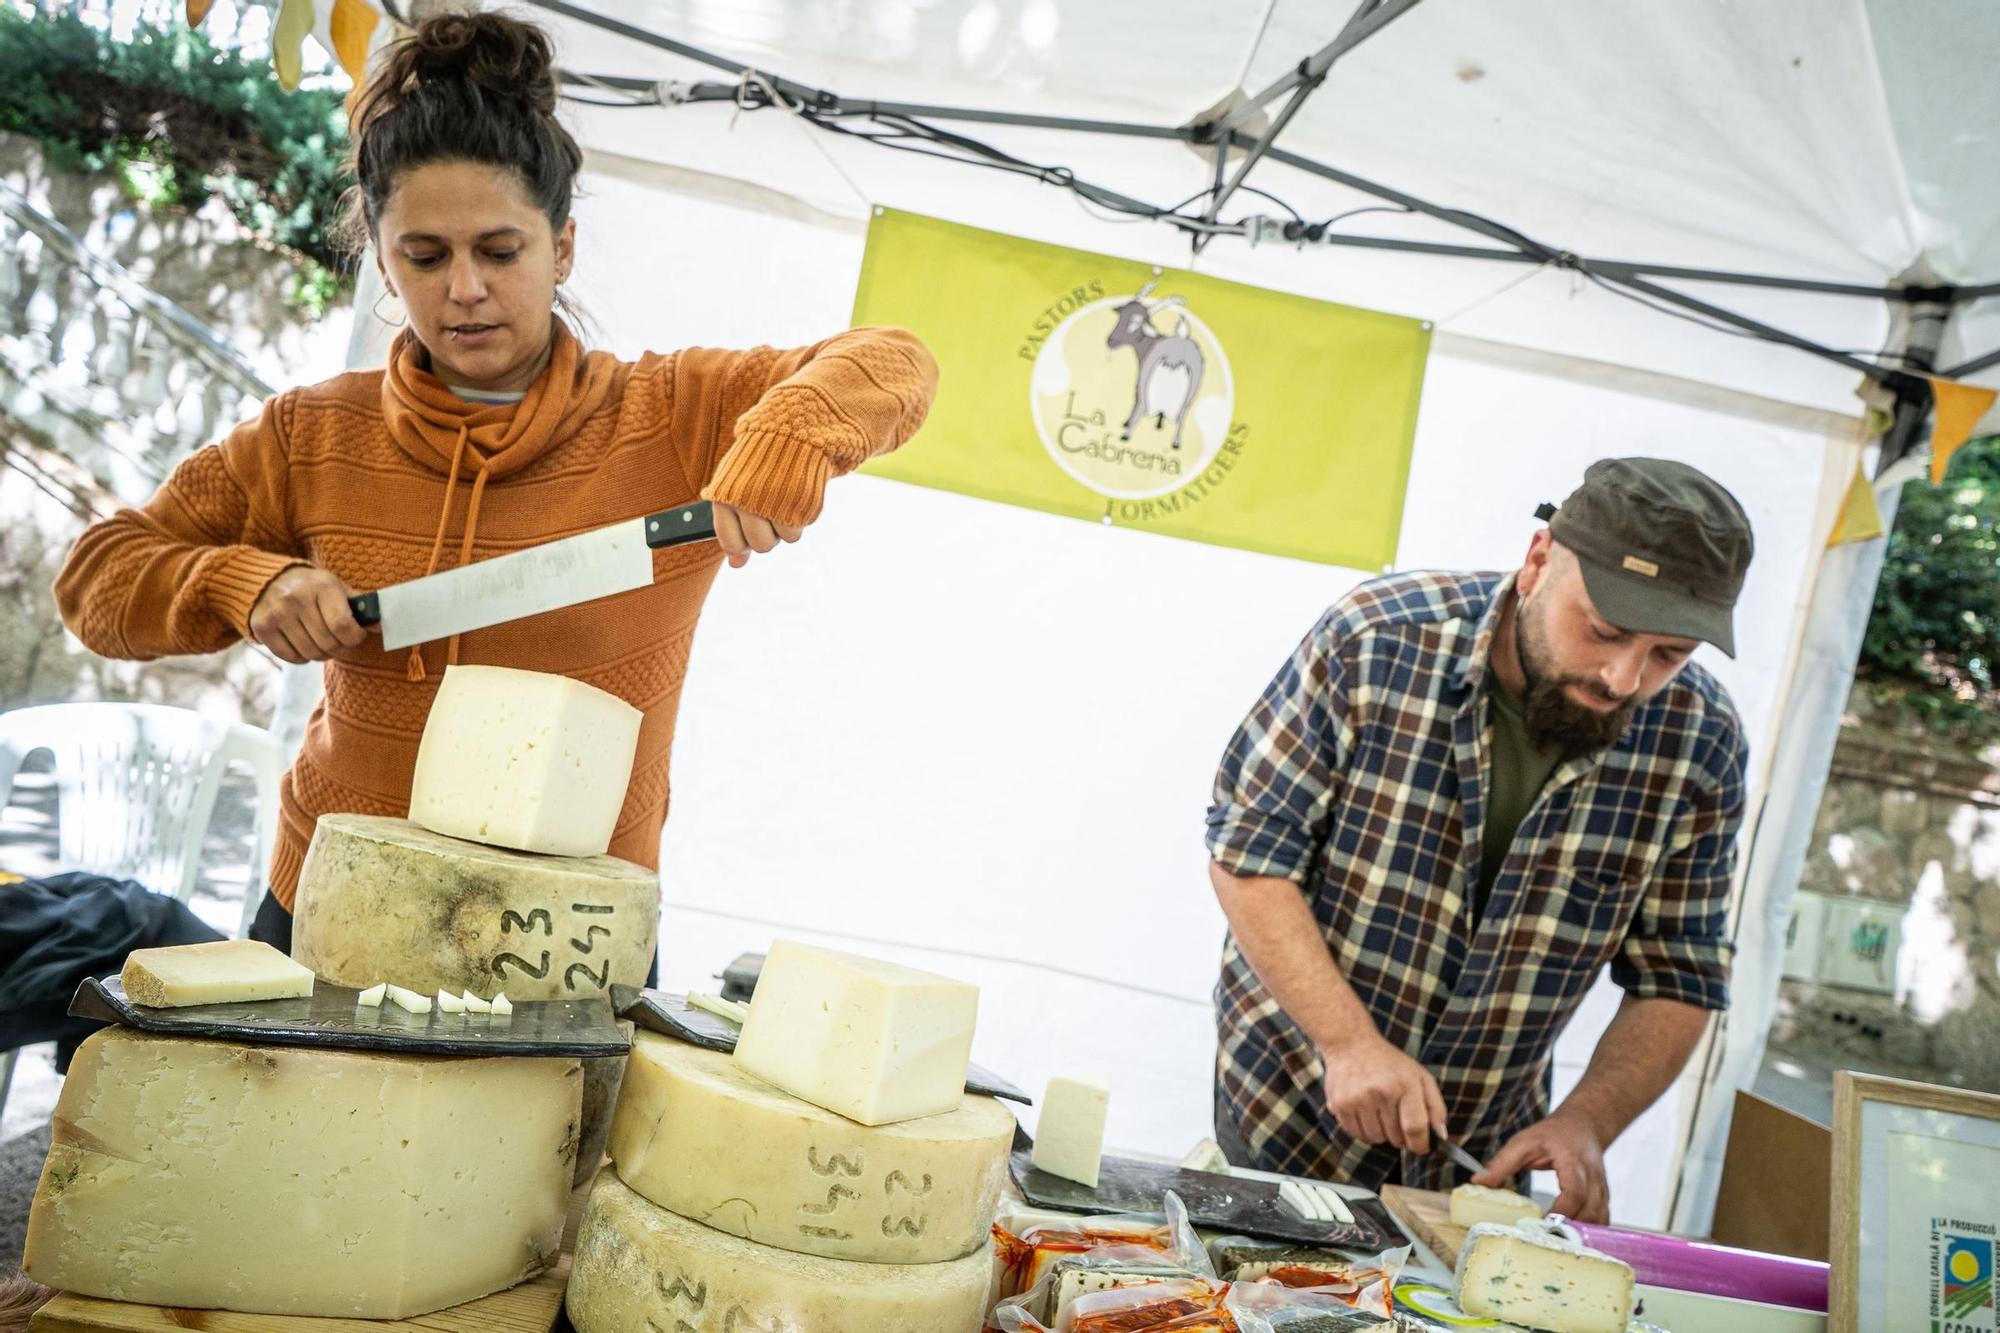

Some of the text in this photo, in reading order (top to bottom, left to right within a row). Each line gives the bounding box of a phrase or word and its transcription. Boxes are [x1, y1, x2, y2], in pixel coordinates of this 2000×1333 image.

[1017, 279, 1105, 361] PASTORS
[1063, 389, 1106, 426] La
[1105, 422, 1250, 521] FORMATGERS
[491, 908, 553, 981] 23
[881, 1169, 933, 1239] 23
[1938, 1218, 1947, 1227] LA
